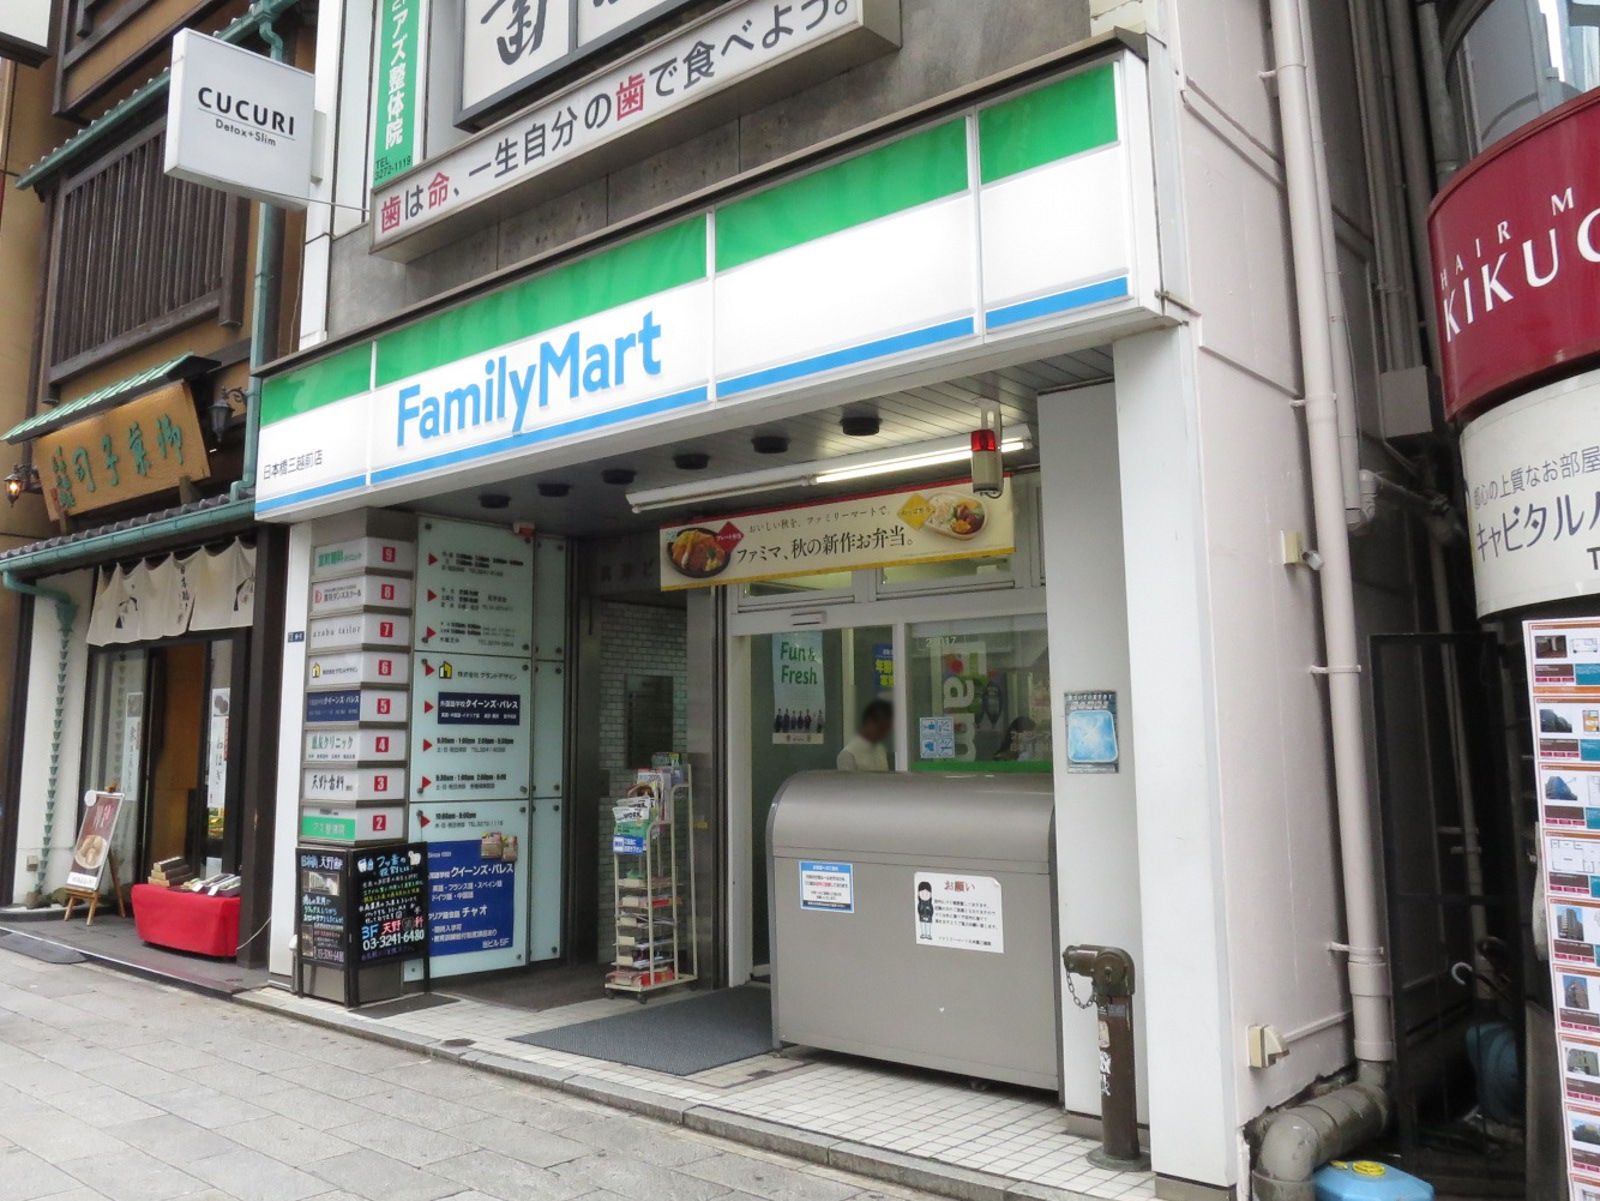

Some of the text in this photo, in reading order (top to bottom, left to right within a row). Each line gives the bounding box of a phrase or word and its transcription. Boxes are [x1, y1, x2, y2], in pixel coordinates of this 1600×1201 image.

[198, 87, 294, 135] CUCURI
[215, 119, 277, 147] Detox+Slim
[376, 156, 389, 168] TEL
[1440, 221, 1511, 290] HAIR
[397, 311, 661, 447] FamilyMart
[263, 449, 323, 480] 日本橋三越前店
[737, 529, 914, 564] ファミマ、秋の新作お弁当。
[383, 624, 390, 637] 7
[780, 642, 806, 660] Fun
[382, 662, 389, 675] 6
[780, 665, 818, 685] Fresh
[380, 699, 387, 712] 5
[378, 738, 386, 751] 4
[377, 777, 385, 790] 3
[376, 816, 383, 830] 2
[944, 880, 976, 893] お願い
[361, 924, 379, 939] 3F
[362, 929, 424, 951] 03-3241-6480
